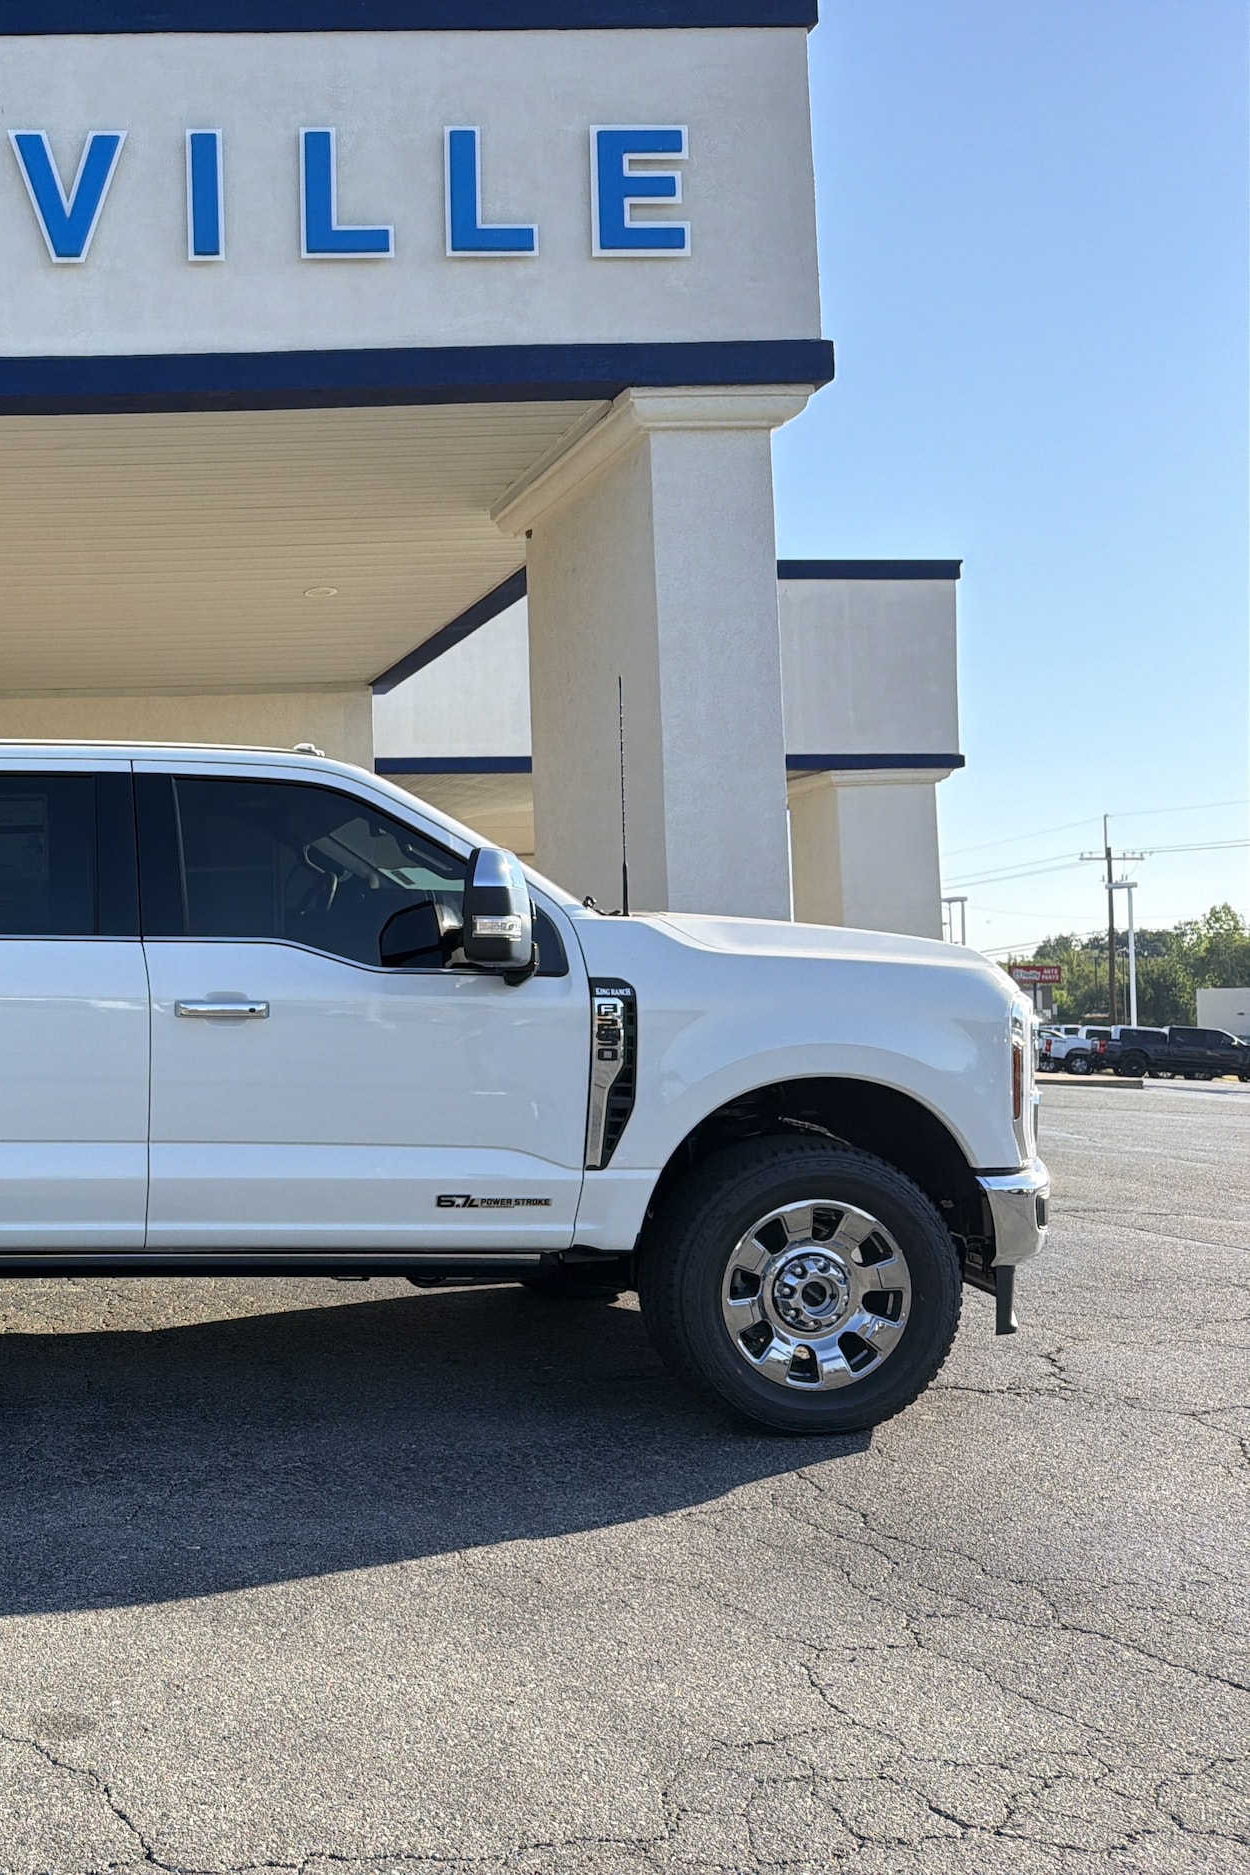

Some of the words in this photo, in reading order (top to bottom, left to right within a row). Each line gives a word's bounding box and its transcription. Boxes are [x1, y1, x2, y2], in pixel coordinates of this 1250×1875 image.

[595, 987, 611, 996] KING
[611, 987, 631, 996] RANCH
[480, 1198, 512, 1206] POWER
[514, 1198, 551, 1206] STROKE
